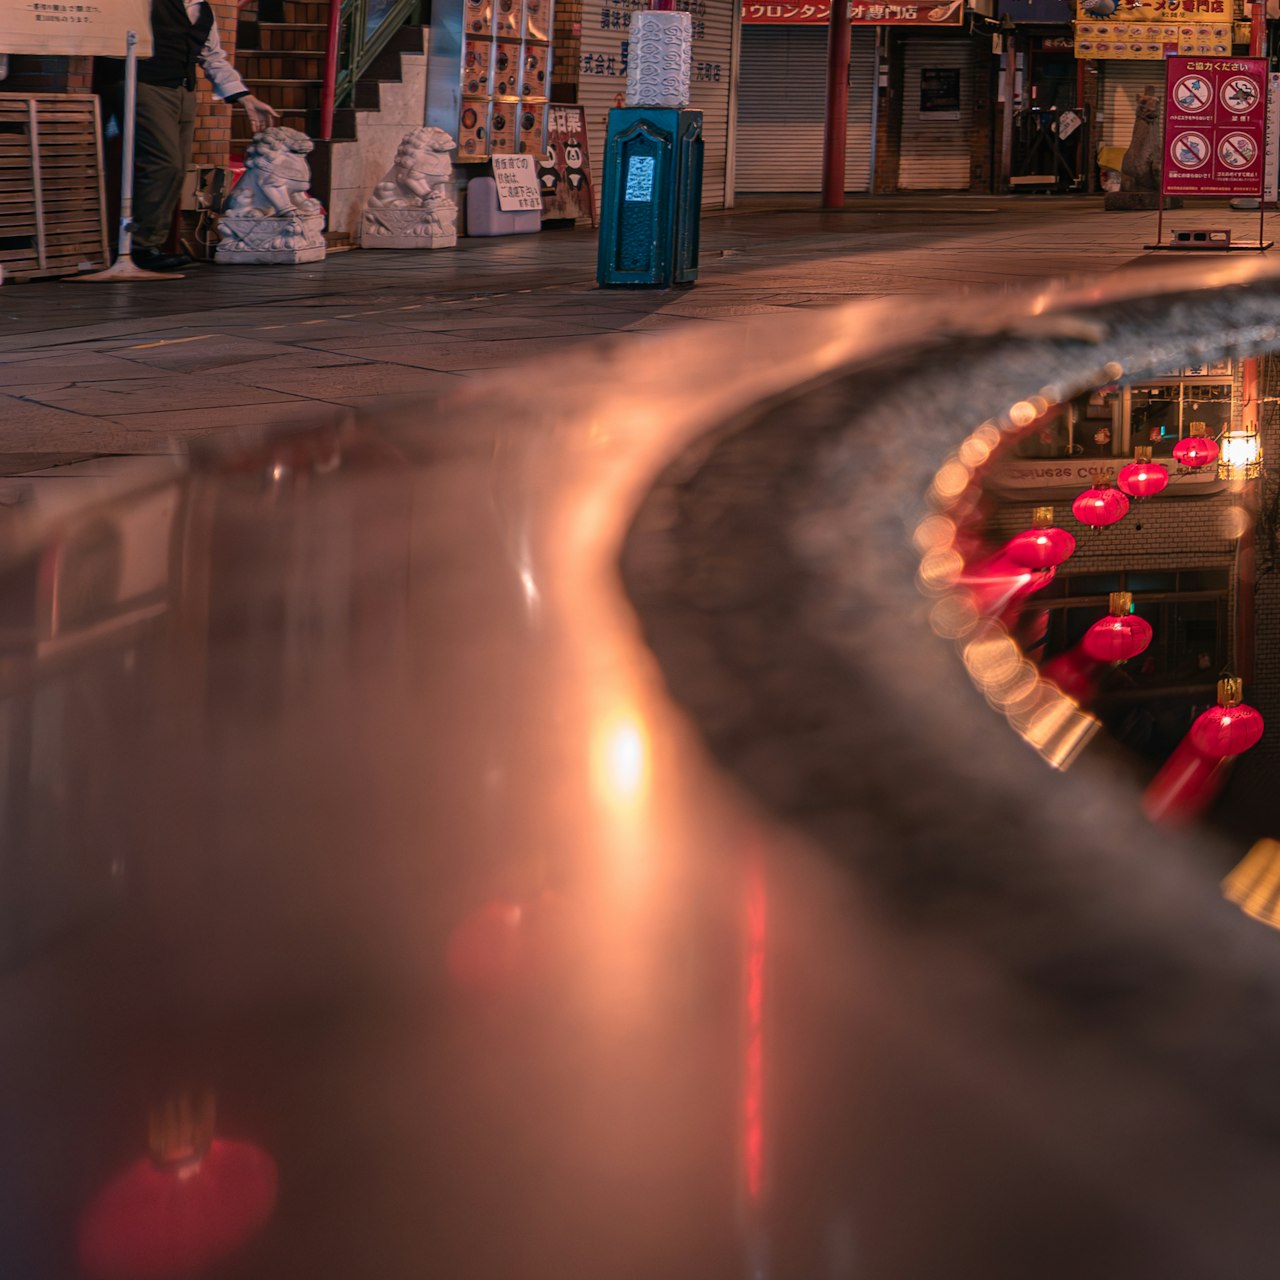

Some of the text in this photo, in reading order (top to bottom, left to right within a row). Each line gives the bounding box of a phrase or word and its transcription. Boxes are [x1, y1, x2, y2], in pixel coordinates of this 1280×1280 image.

[580, 53, 616, 76] 式会社
[1186, 61, 1249, 71] ご協力ください
